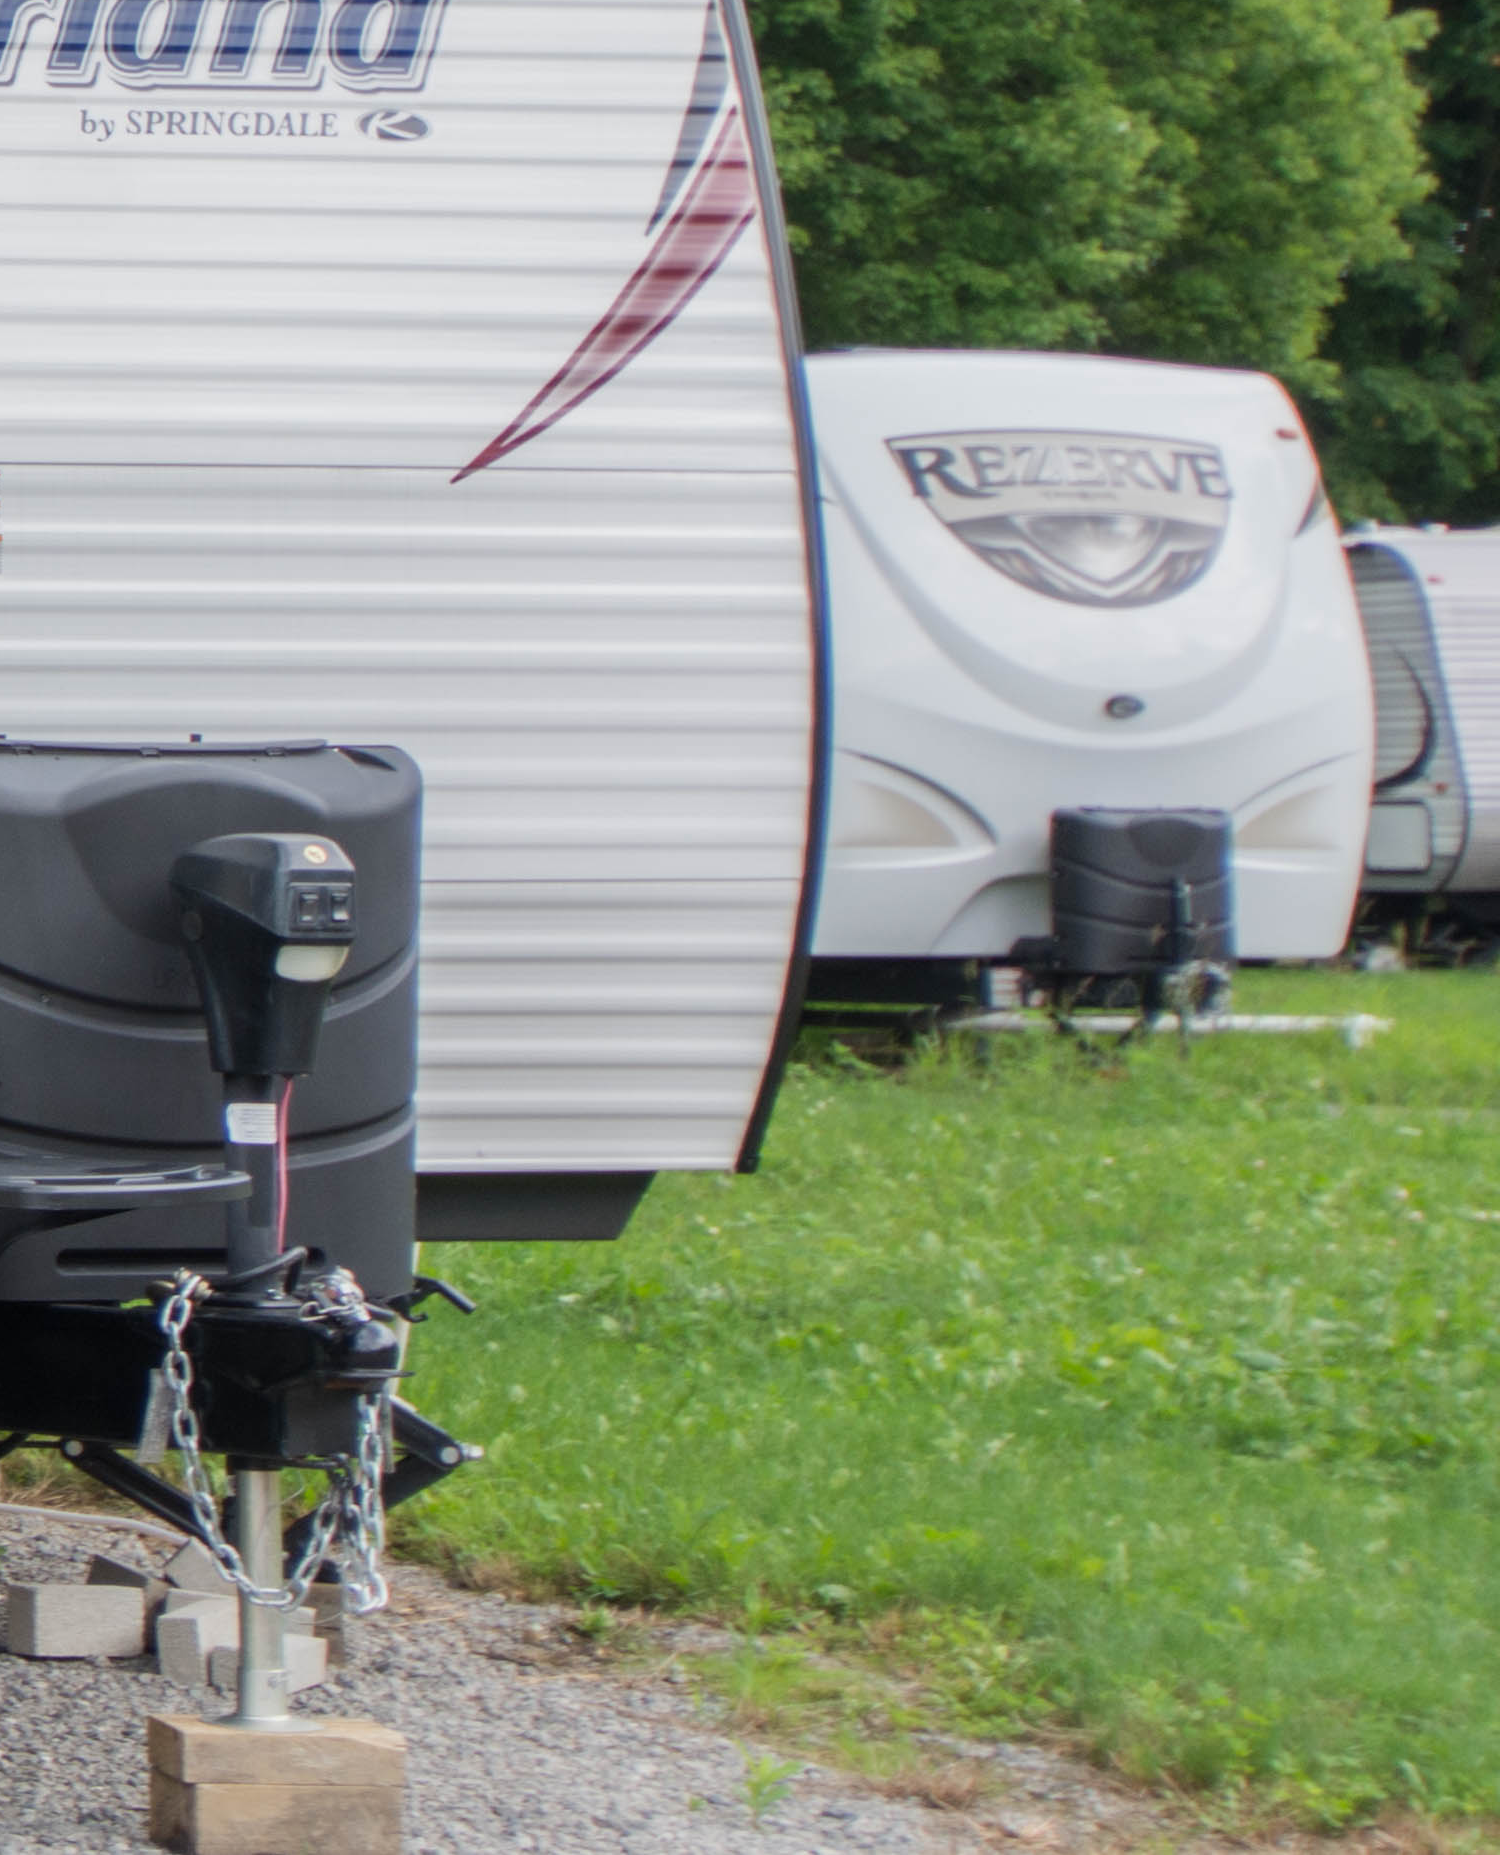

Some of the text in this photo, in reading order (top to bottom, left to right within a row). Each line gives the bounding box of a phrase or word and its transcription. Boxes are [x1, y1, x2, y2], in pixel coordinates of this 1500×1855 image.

[79, 109, 339, 142] by SPRINGDALE
[896, 444, 1234, 500] REZERVE
